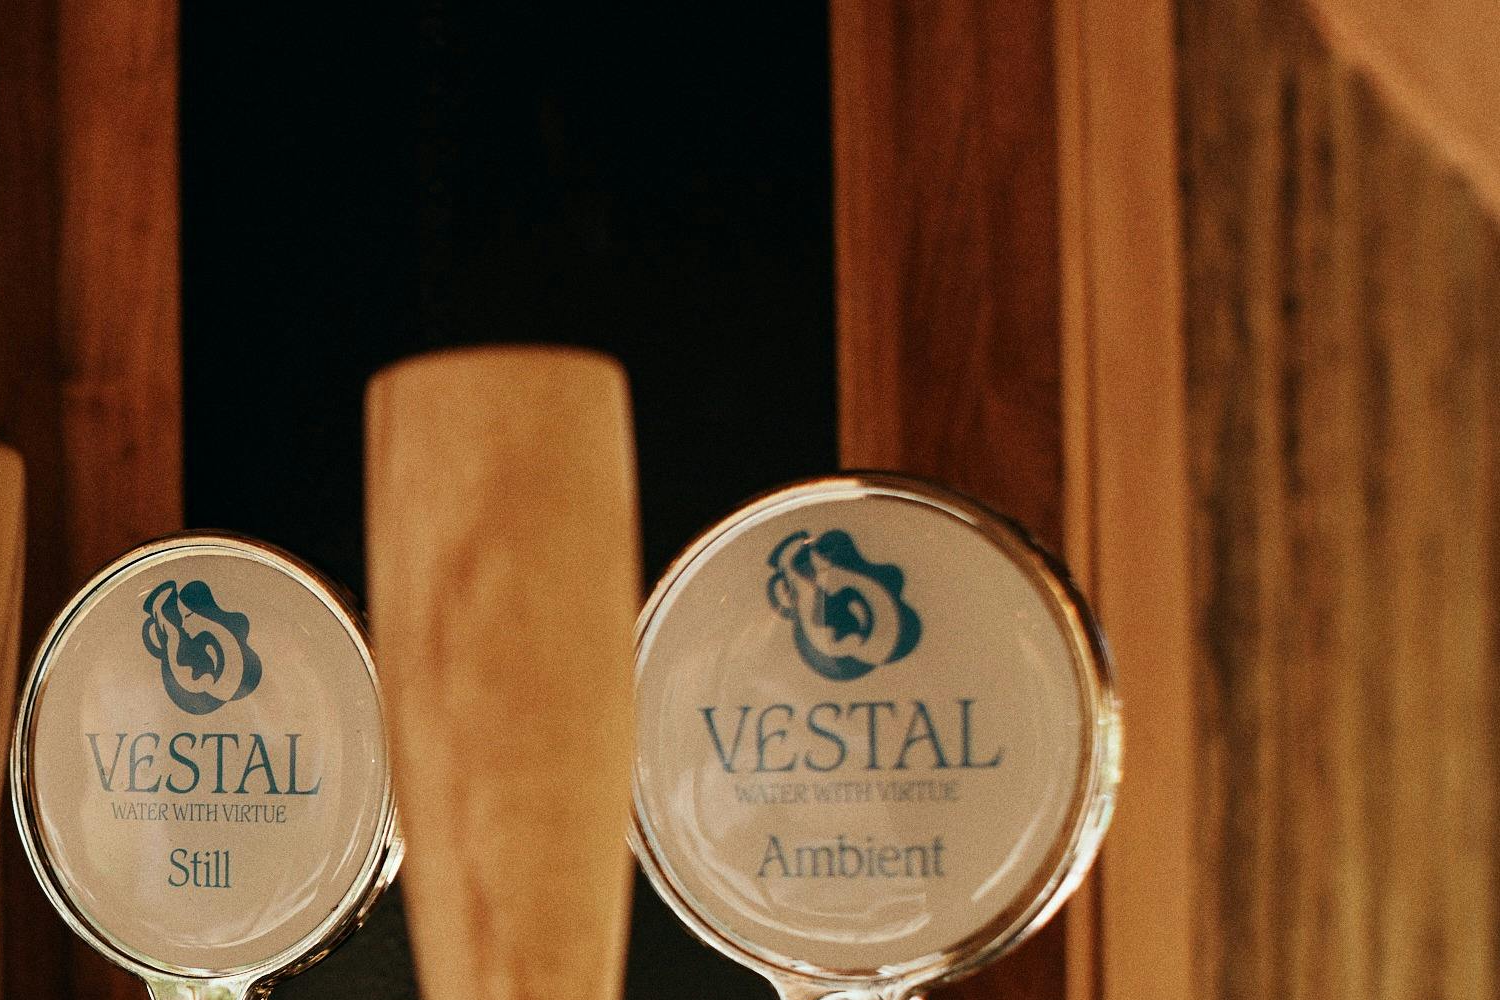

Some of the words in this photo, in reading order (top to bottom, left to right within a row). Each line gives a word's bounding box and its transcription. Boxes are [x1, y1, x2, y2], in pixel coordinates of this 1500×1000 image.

[698, 697, 1004, 774] VESTAL
[85, 731, 322, 795] VESTAL
[111, 802, 169, 821] WATER
[172, 803, 218, 822] WITH
[222, 804, 287, 823] VIRTUE
[167, 848, 232, 888] Still
[757, 834, 945, 879] Ambient
